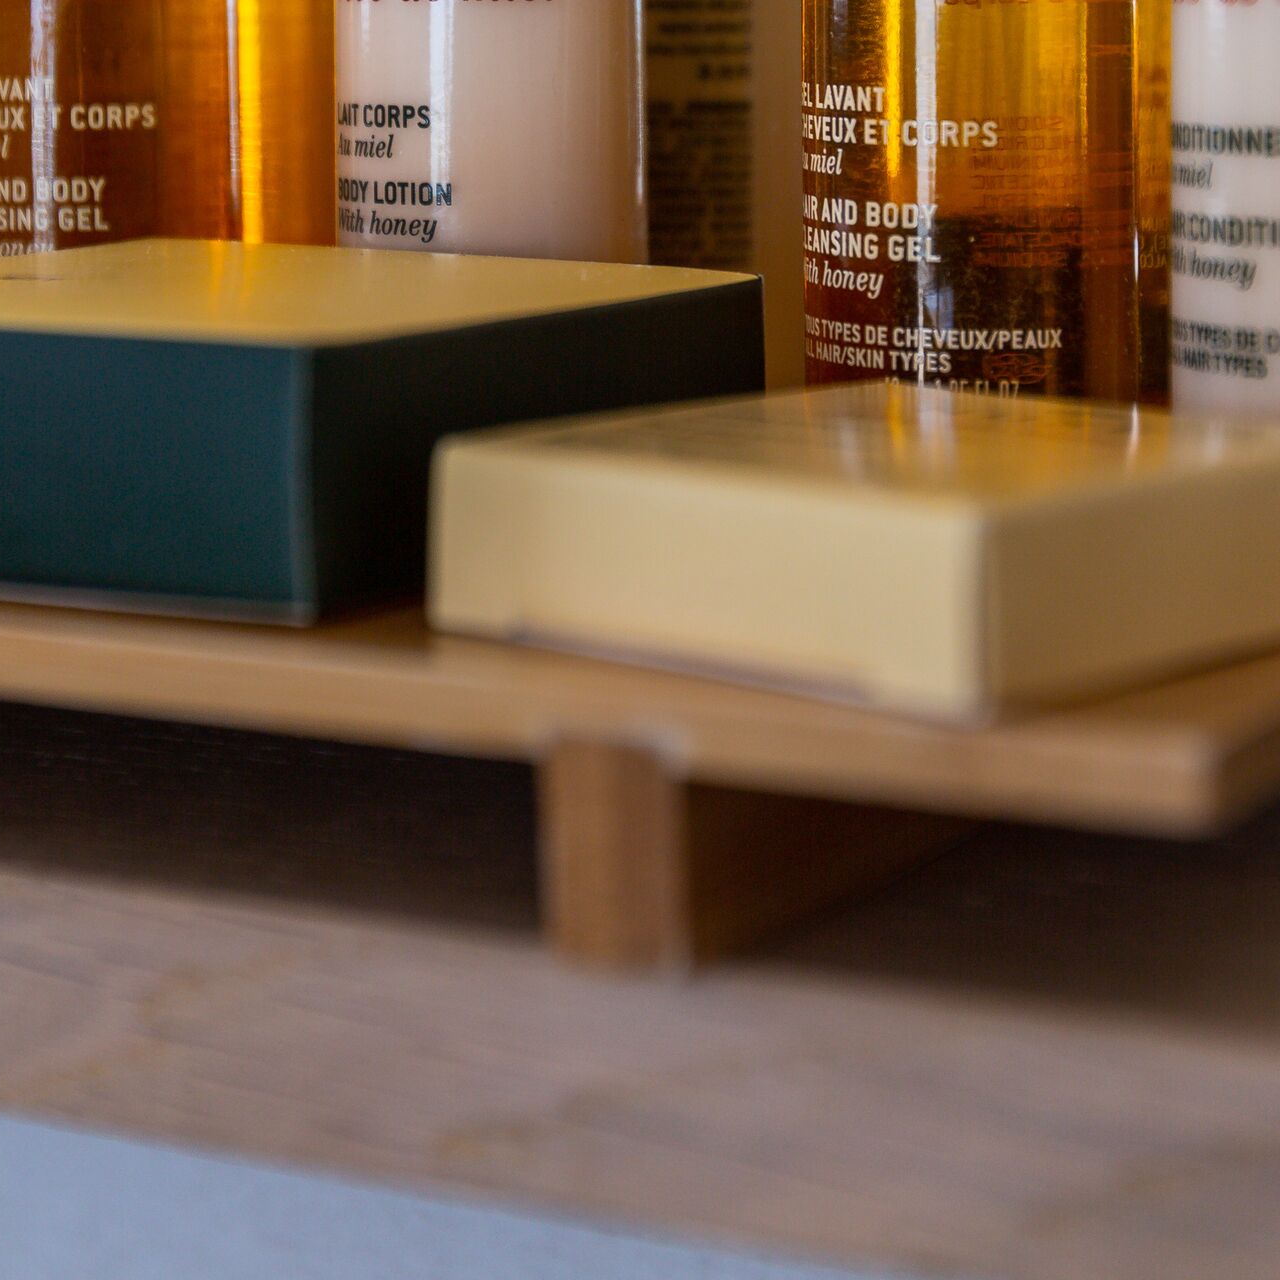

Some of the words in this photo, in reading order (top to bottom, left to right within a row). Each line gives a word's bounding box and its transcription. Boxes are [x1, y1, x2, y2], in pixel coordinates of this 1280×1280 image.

[801, 81, 813, 108] EL
[815, 83, 886, 114] LAVANT
[34, 105, 62, 130] ET
[70, 102, 157, 131] CORPS
[337, 102, 359, 127] LAIT
[363, 104, 432, 129] CORPS
[801, 113, 858, 145] HEVEUX
[863, 118, 891, 146] ET
[902, 119, 1000, 149] CORPS
[337, 133, 352, 156] Au
[354, 134, 395, 159] miel
[810, 147, 843, 176] miel
[36, 177, 105, 203] BODY
[338, 177, 369, 203] BODY
[373, 181, 453, 207] LOTION
[58, 206, 109, 232] GEL
[338, 206, 365, 234] With
[370, 209, 438, 244] honey
[803, 194, 818, 221] AIR
[821, 197, 859, 227] AND
[865, 201, 939, 230] BODY
[803, 225, 879, 262] LEANSING
[887, 233, 942, 264] GEL
[822, 260, 884, 300] honey
[1190, 247, 1258, 291] honey
[821, 318, 861, 344] TYPES
[865, 324, 889, 347] DE
[892, 326, 1063, 351] CHEVEUX/PEAUX
[816, 342, 885, 370] HAIR/SKIN
[889, 351, 953, 374] TYPES
